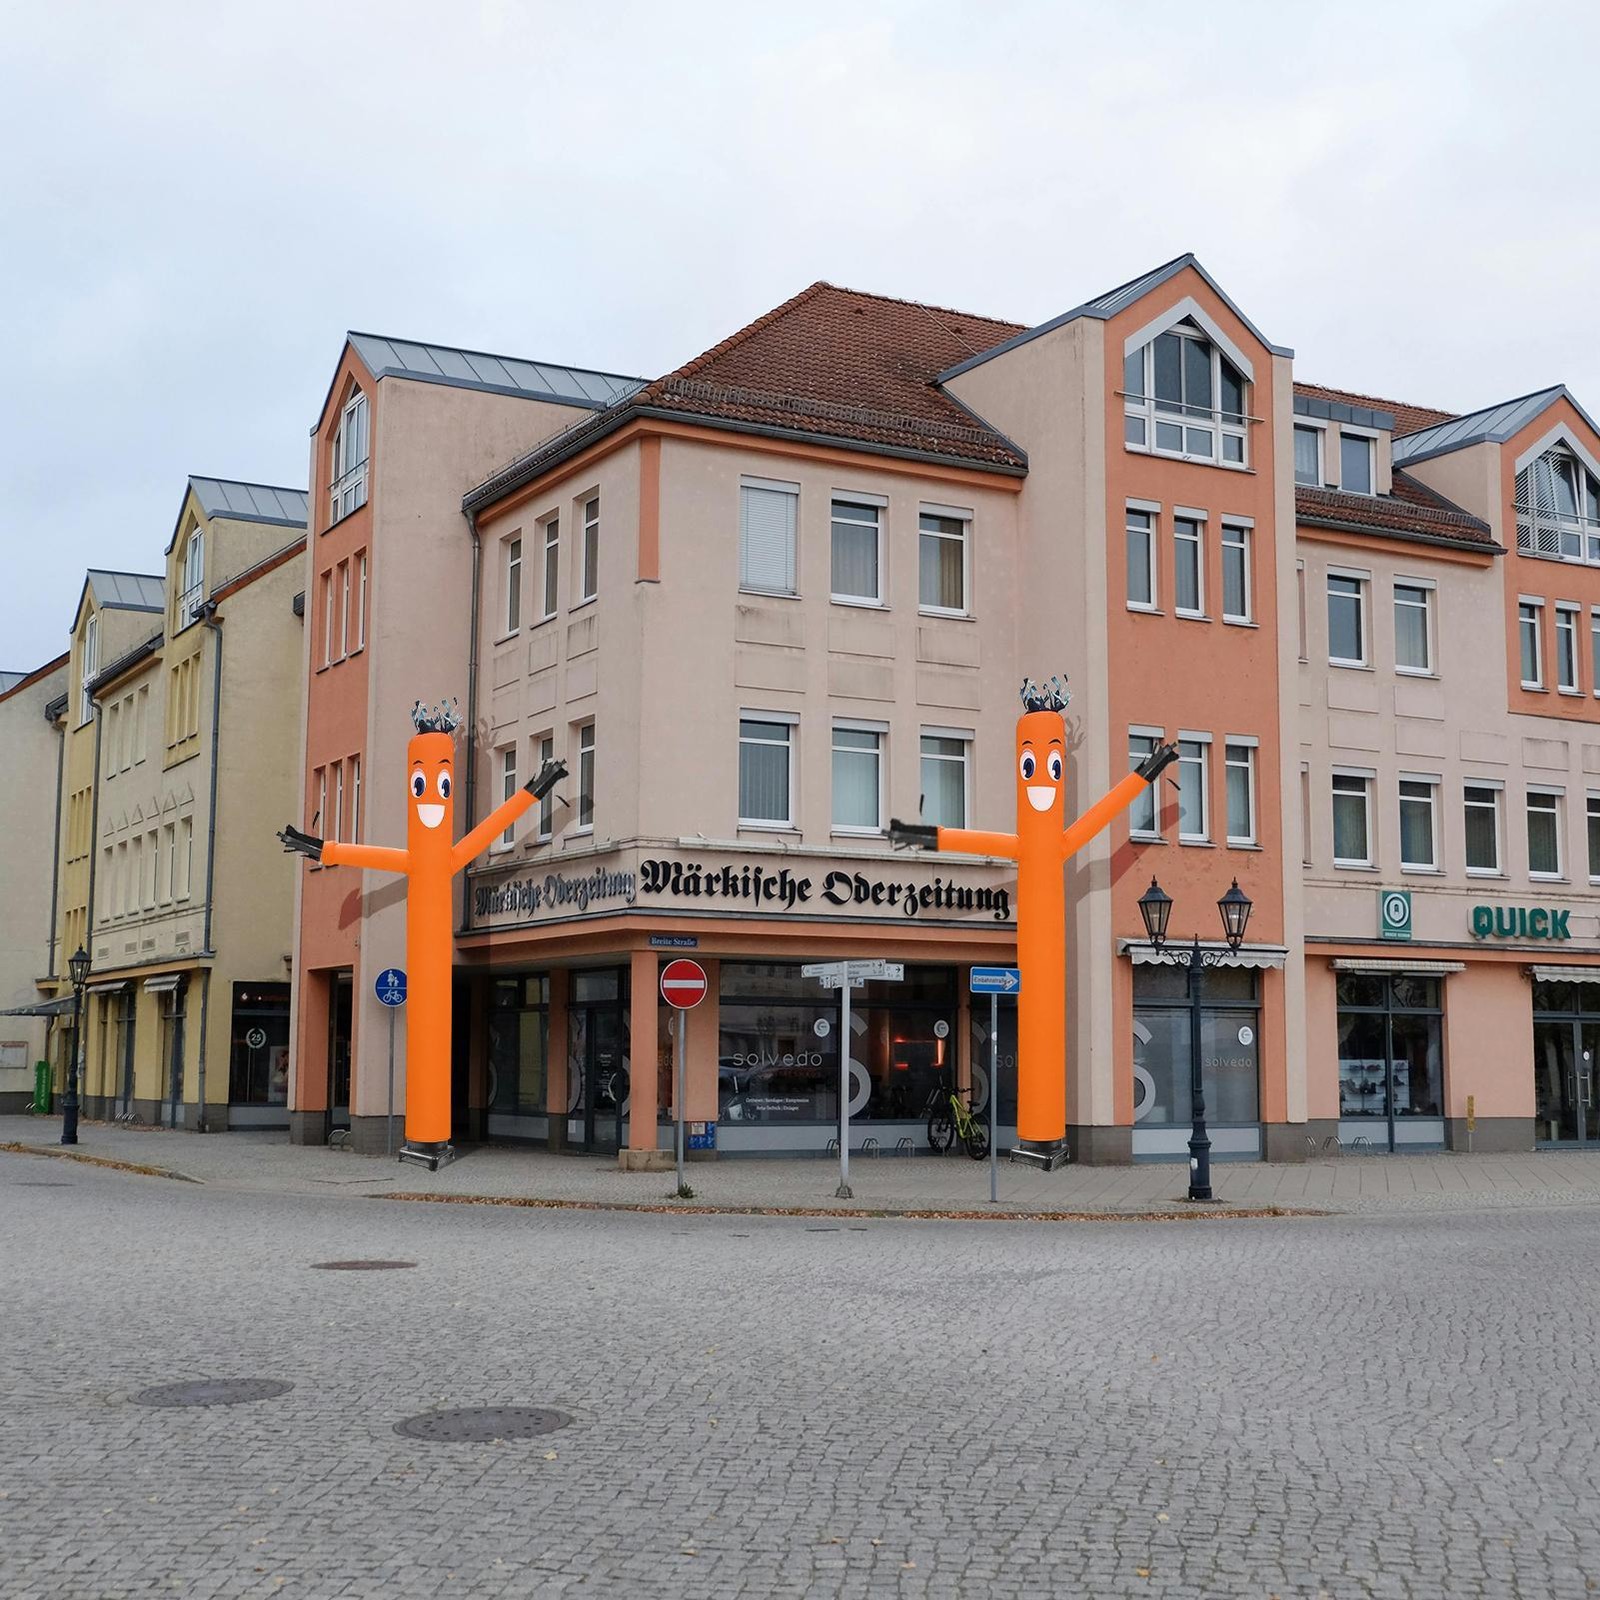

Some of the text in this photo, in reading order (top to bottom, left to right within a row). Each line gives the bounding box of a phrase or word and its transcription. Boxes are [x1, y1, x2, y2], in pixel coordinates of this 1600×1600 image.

[822, 871, 1011, 920] Oderzeitung
[1472, 905, 1572, 939] QUICK
[733, 1051, 823, 1067] solvedo
[1205, 1056, 1252, 1068] solvedo
